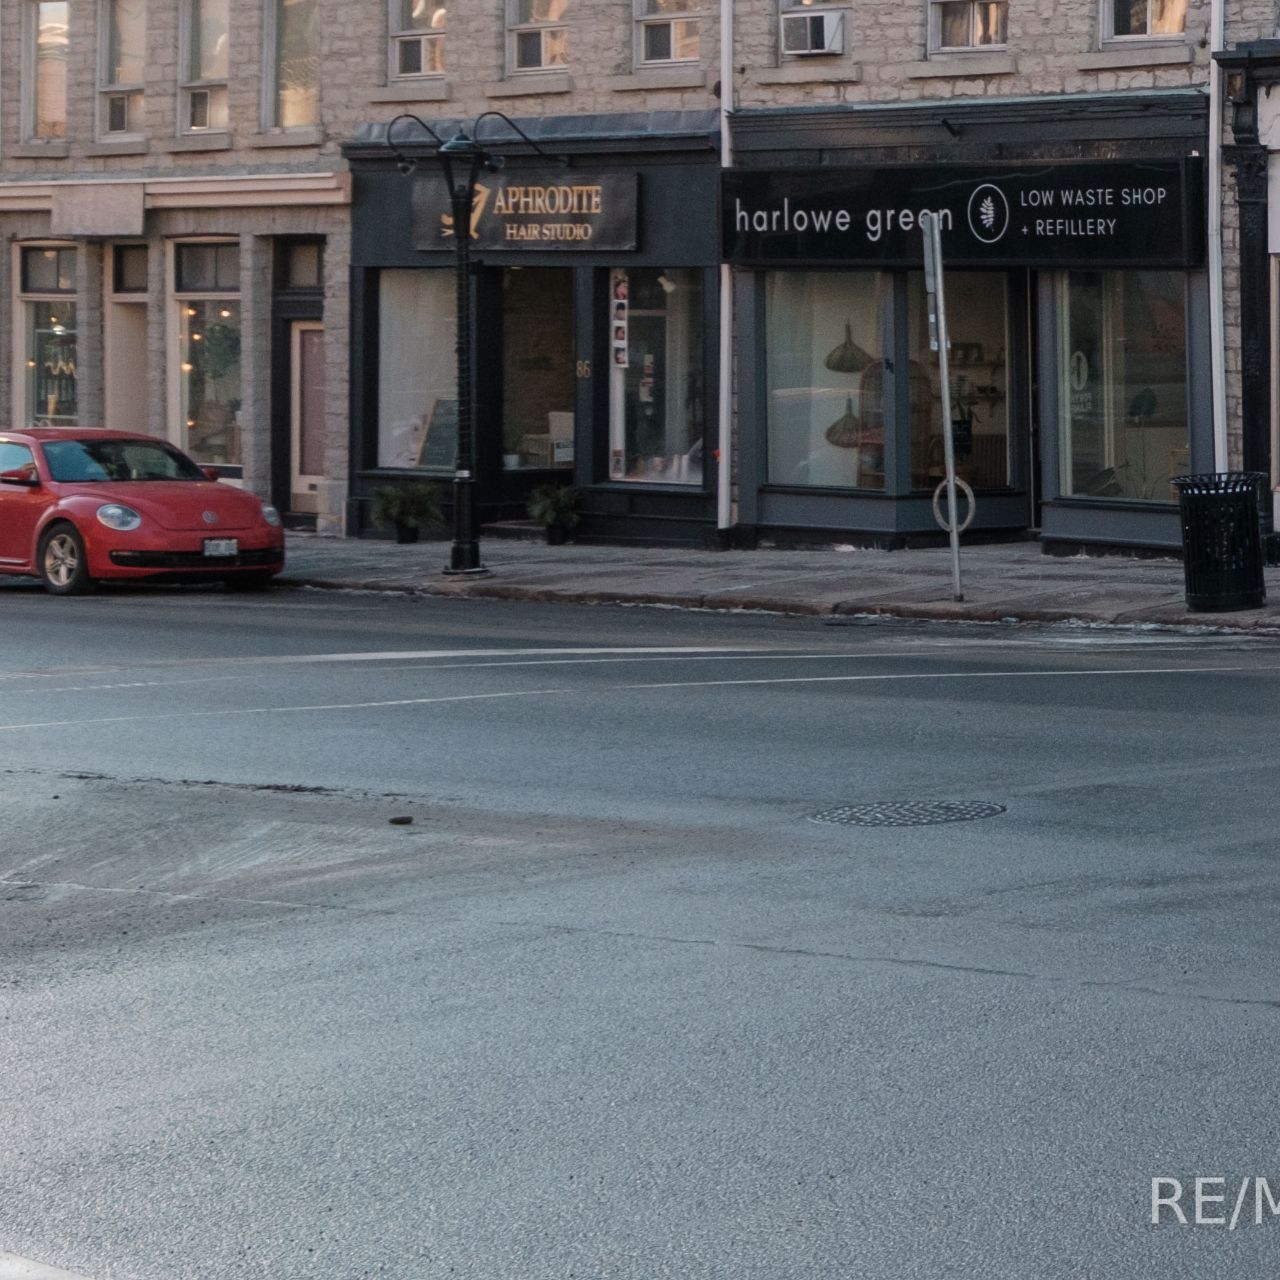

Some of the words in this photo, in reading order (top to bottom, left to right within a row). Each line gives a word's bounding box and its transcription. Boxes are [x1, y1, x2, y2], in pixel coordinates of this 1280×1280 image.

[492, 185, 602, 214] APHRODITE
[1020, 189, 1054, 207] LOW
[1061, 188, 1114, 206] WASTE
[1121, 187, 1167, 205] SHOP
[735, 197, 850, 231] harlowe
[505, 223, 541, 240] HAIR
[541, 223, 593, 240] STUDIO
[1035, 219, 1117, 235] REFILLERY
[576, 360, 592, 378] 86
